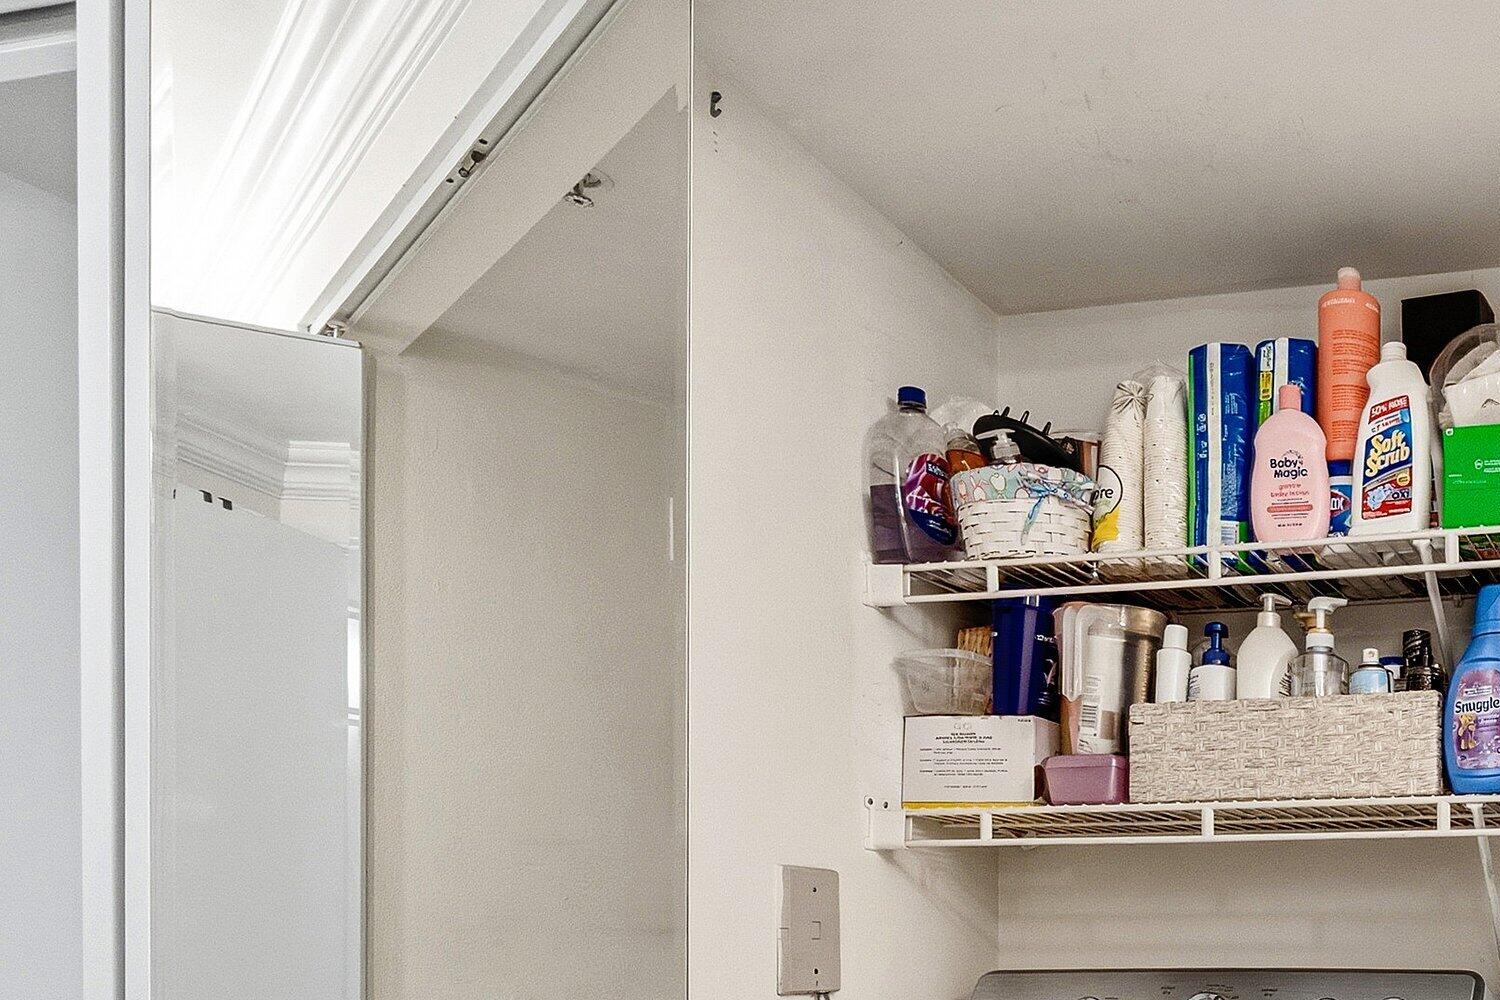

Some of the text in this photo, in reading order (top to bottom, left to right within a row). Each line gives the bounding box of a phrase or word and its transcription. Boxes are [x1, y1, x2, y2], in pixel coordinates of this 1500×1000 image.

[1370, 429, 1406, 457] Soft
[1270, 457, 1298, 469] Baby
[1365, 443, 1411, 477] Scrub
[1273, 466, 1308, 480] Magic
[1454, 697, 1500, 713] Snuggle
